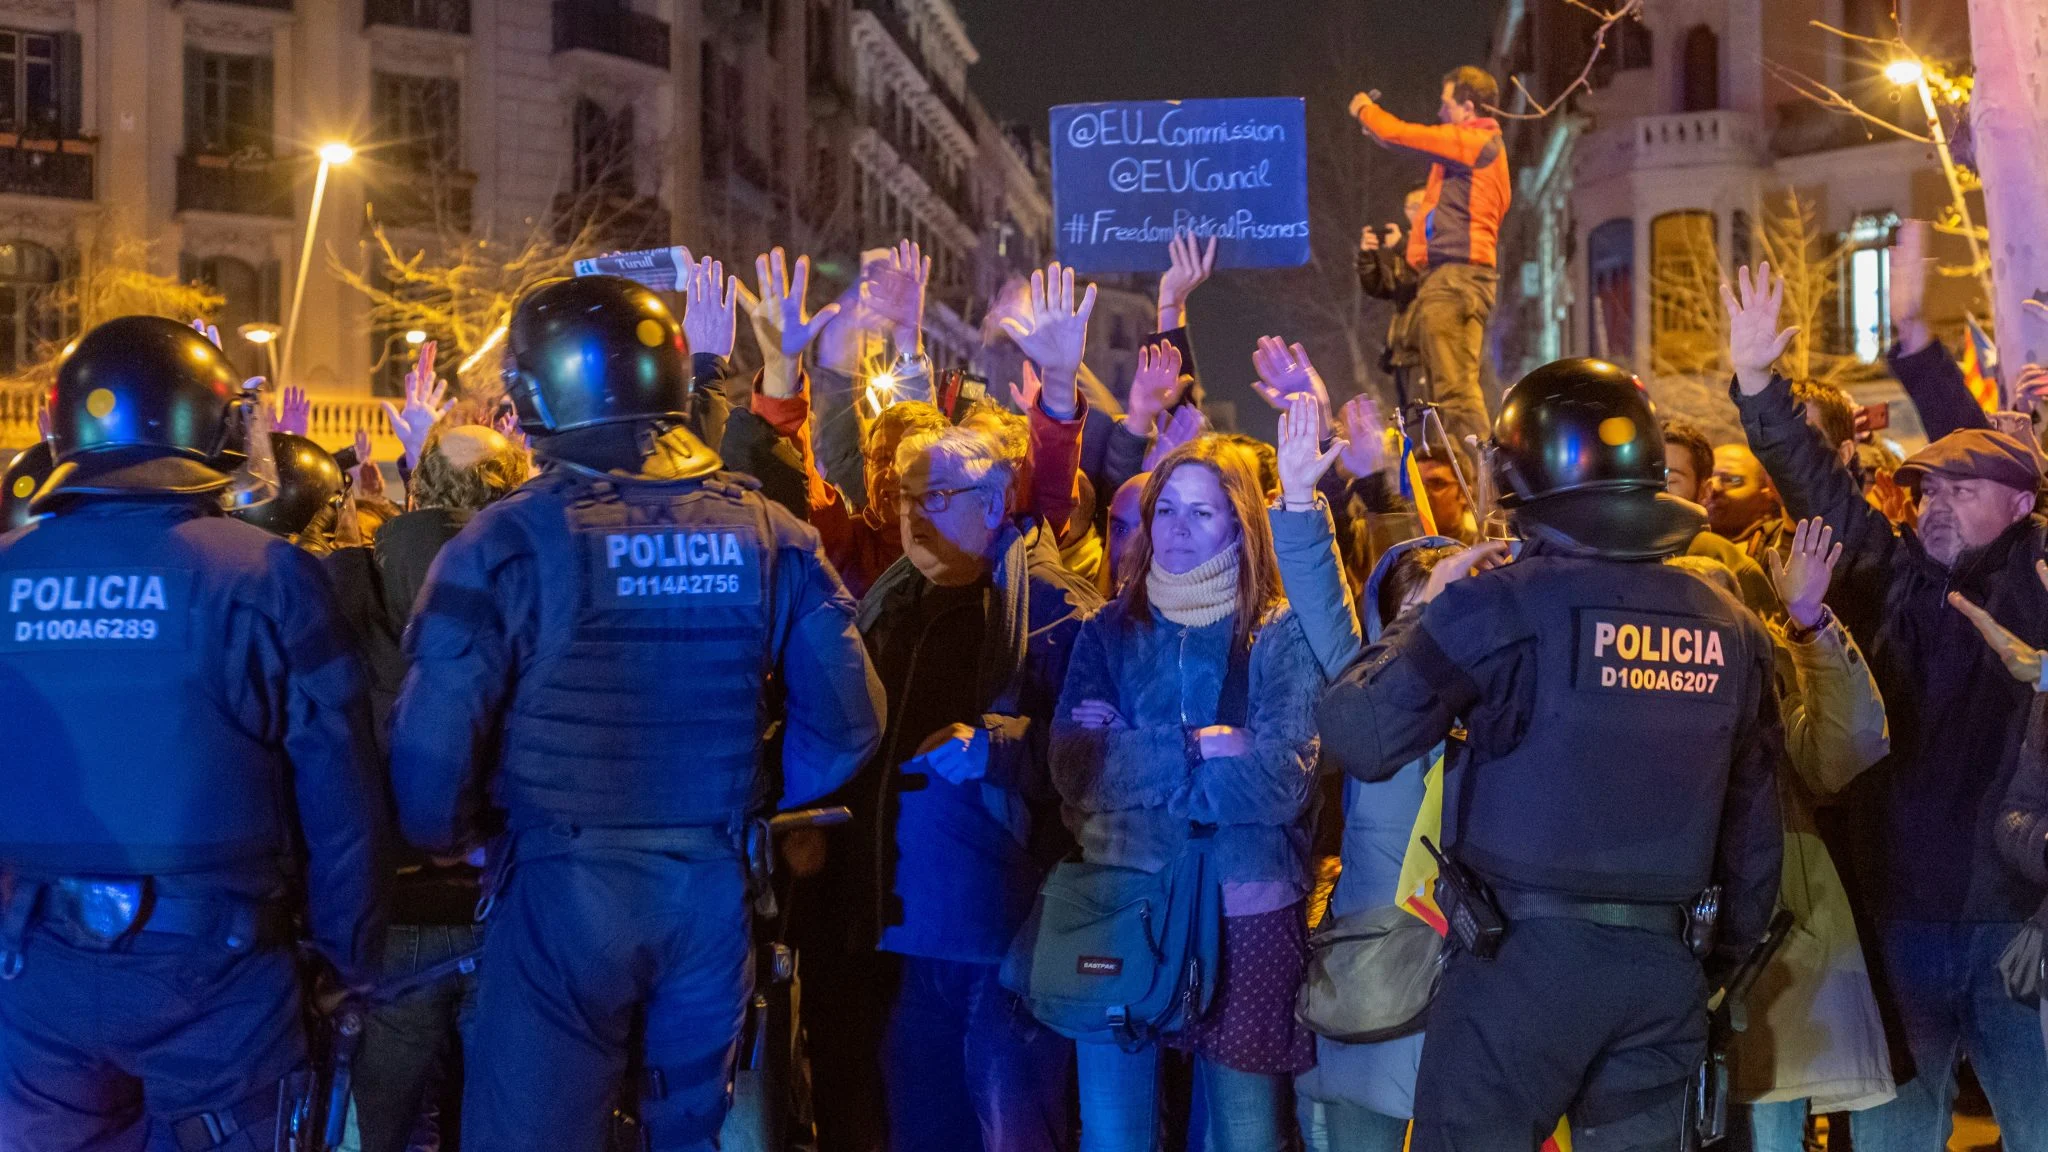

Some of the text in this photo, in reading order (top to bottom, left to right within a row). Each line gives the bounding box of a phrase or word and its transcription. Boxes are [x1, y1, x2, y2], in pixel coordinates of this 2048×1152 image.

[1068, 108, 1285, 148] @EU_Commission
[615, 256, 655, 270] Turull
[606, 533, 745, 568] POLICIA
[8, 575, 168, 613] POLICIA
[616, 574, 739, 597] D114A2756
[15, 618, 158, 642] D100A6289
[1594, 622, 1725, 666] POLICIA
[1601, 666, 1719, 694] D100A6207
